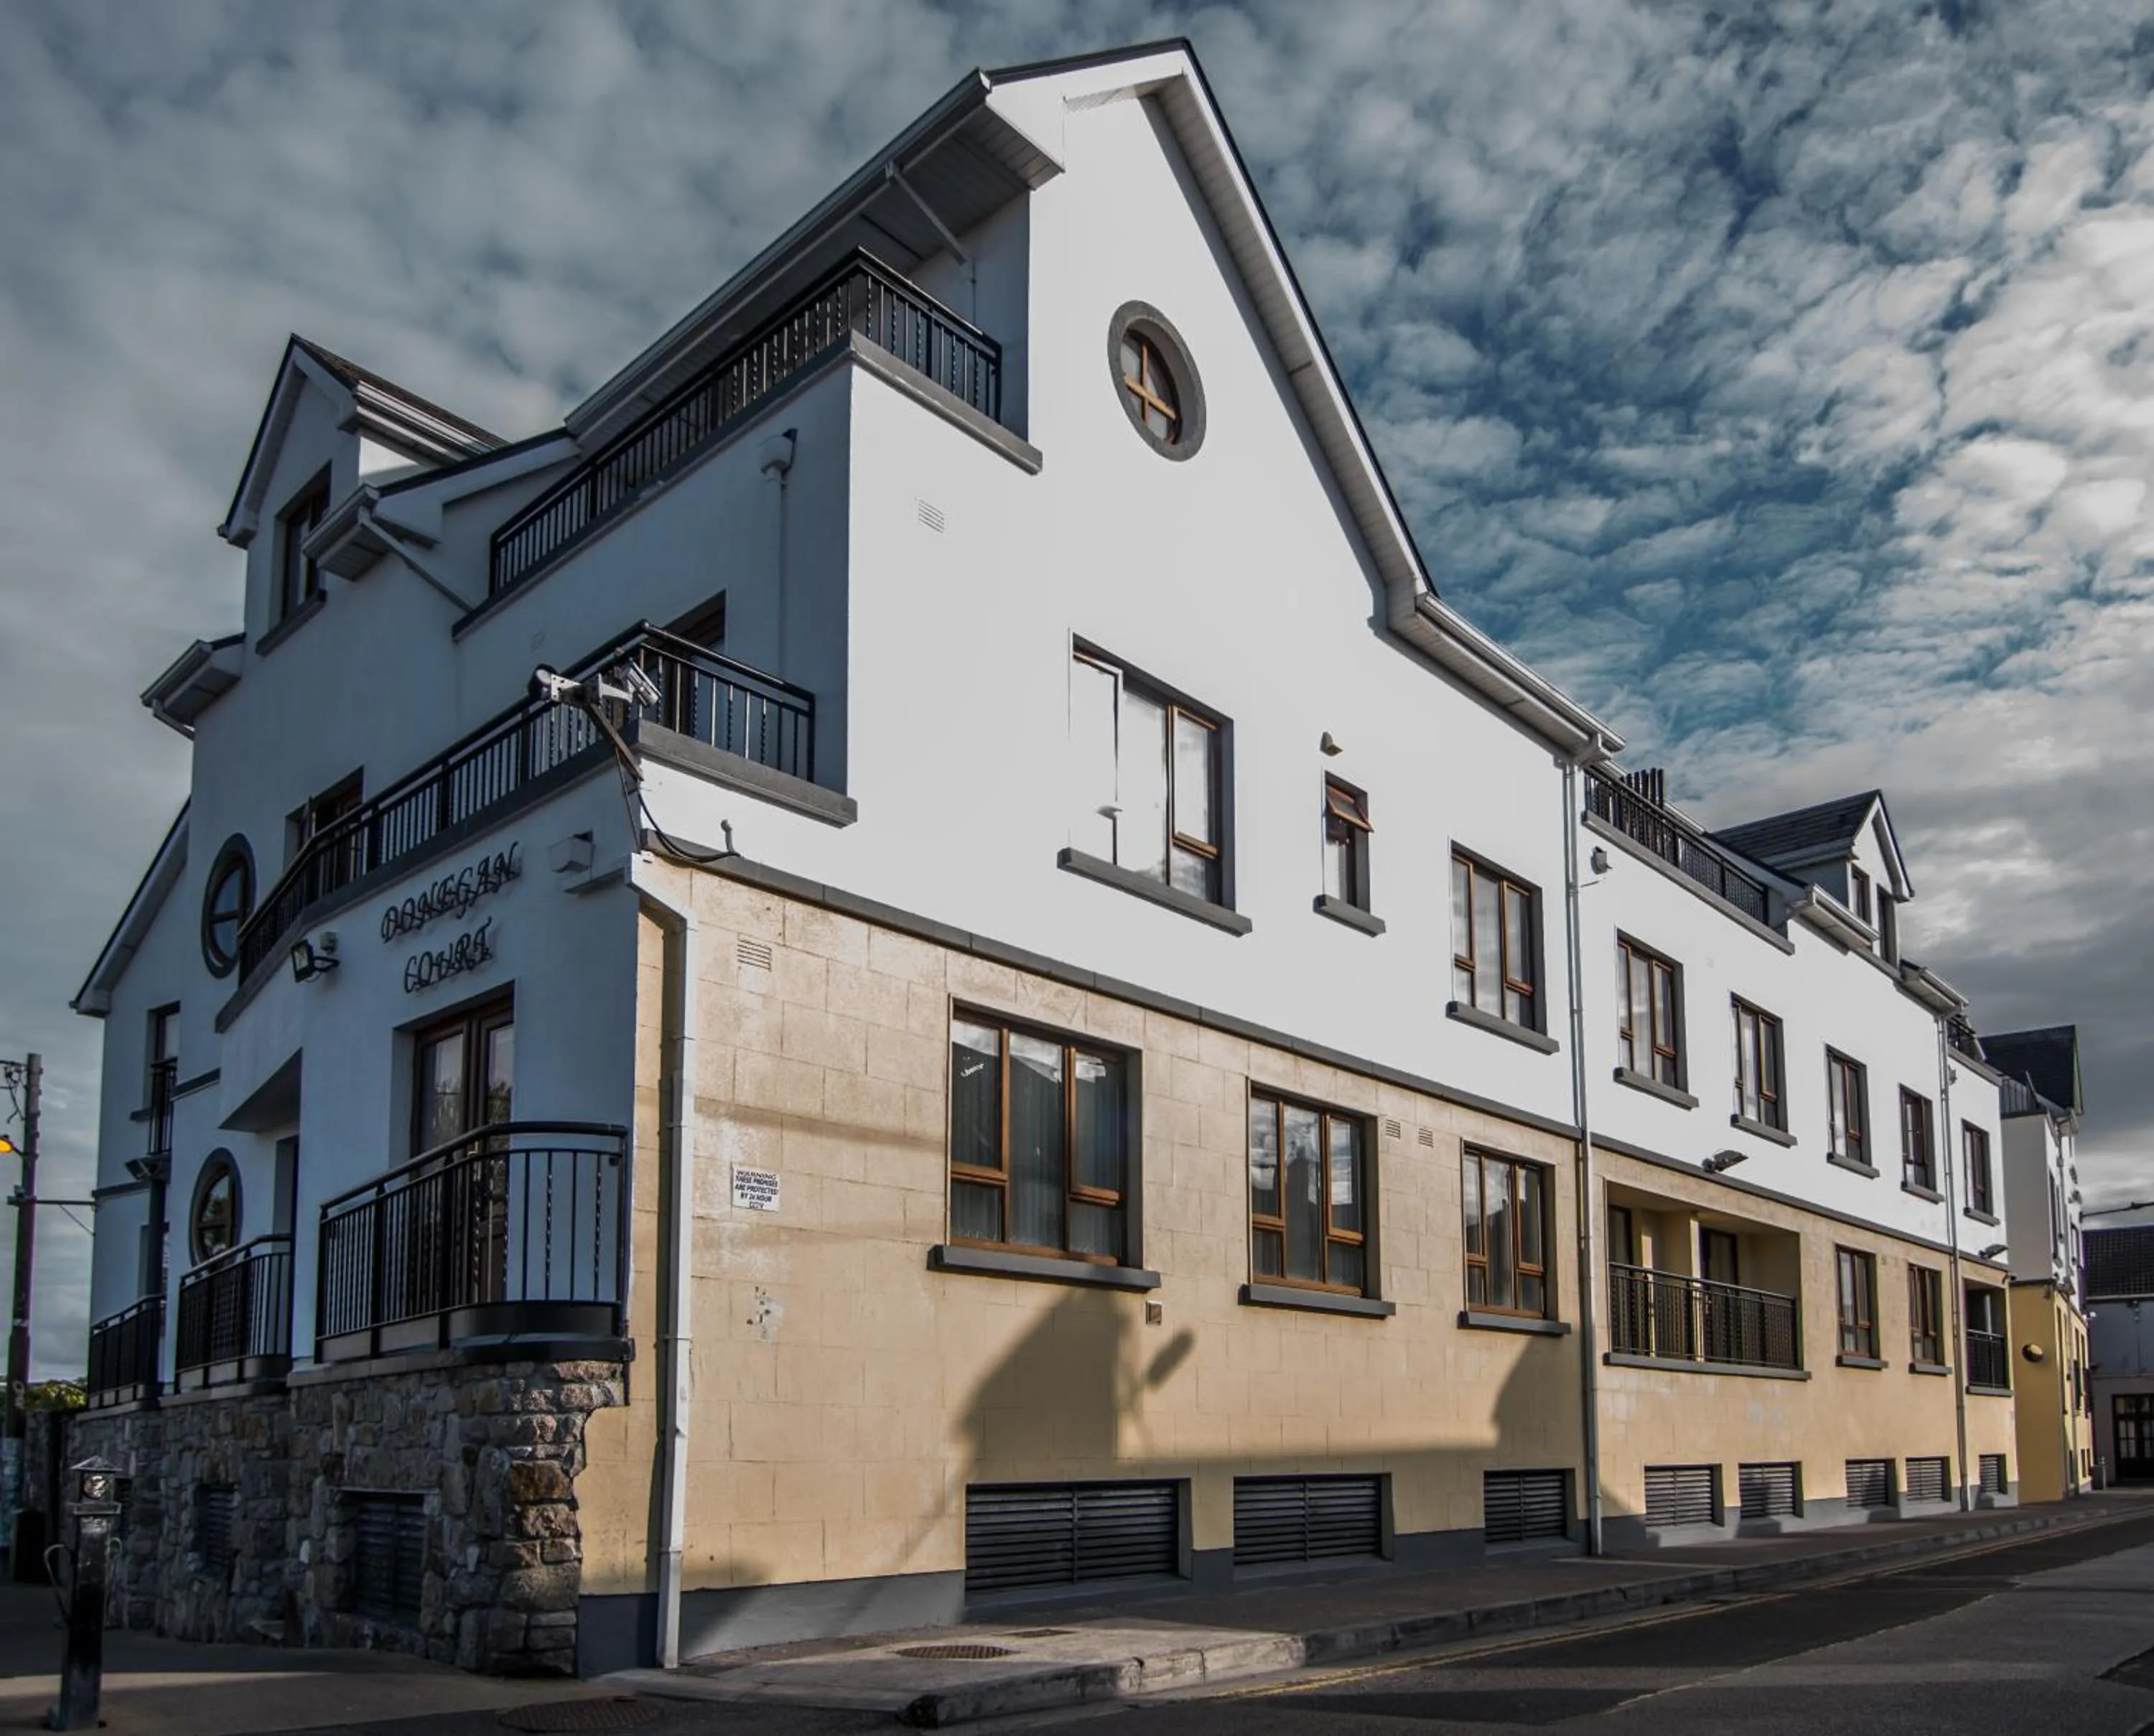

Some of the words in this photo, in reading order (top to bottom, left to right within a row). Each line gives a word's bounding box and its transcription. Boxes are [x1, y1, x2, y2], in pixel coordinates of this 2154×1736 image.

[381, 841, 520, 943] DONEGAN
[404, 915, 493, 994] COURT
[737, 1170, 776, 1180] WARNING
[747, 1185, 778, 1195] PROTECTED
[756, 1194, 772, 1203] HOUR
